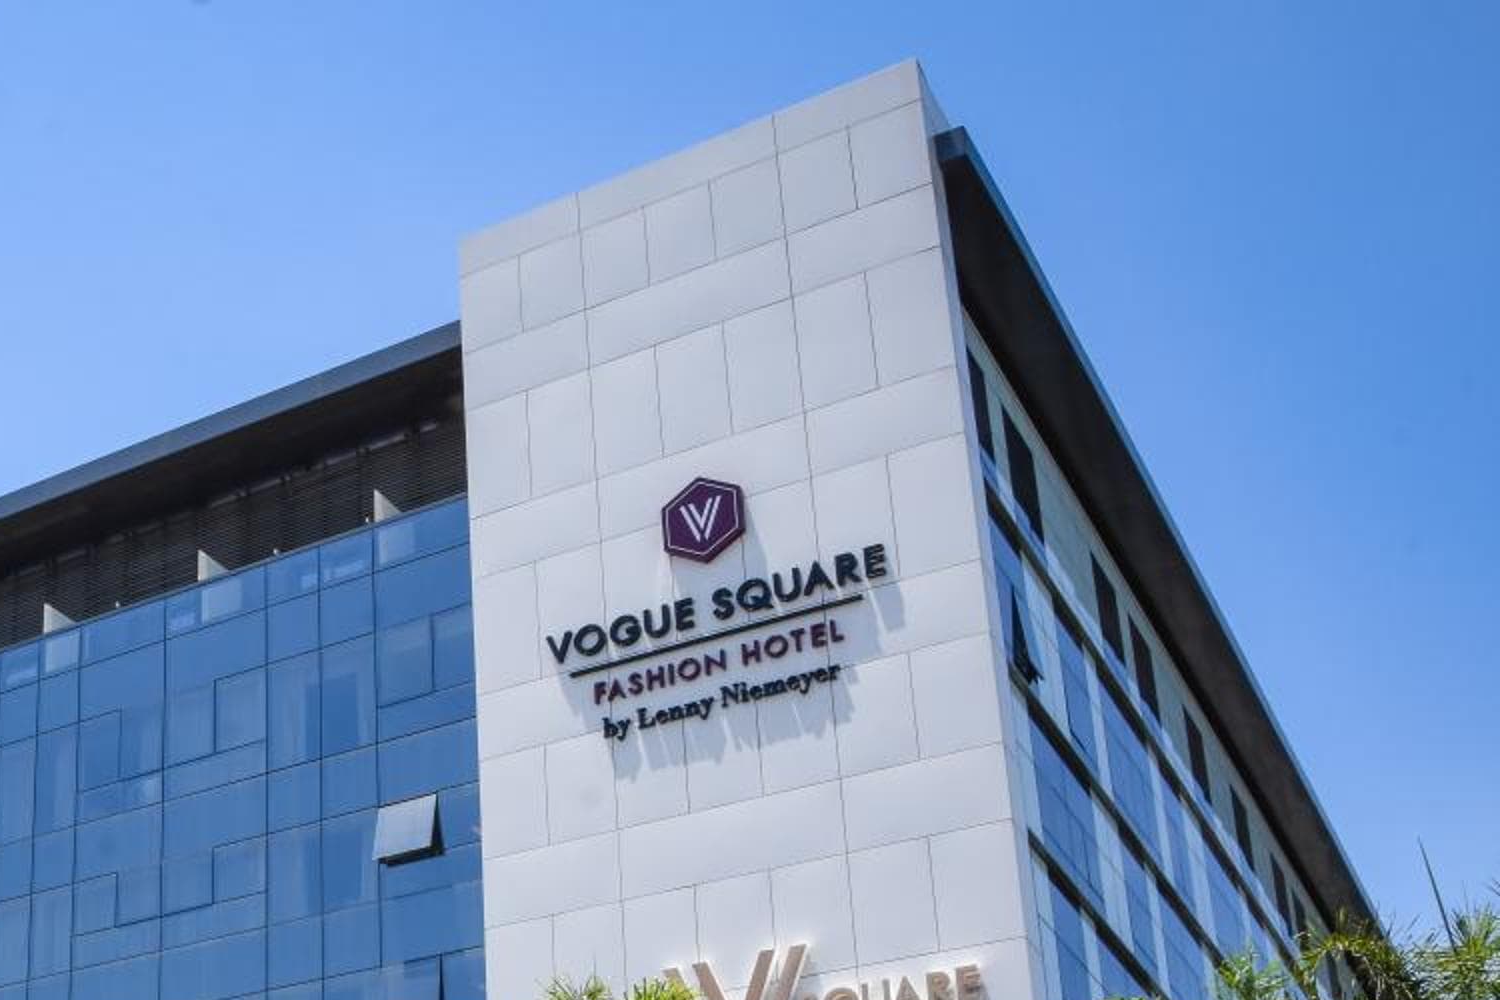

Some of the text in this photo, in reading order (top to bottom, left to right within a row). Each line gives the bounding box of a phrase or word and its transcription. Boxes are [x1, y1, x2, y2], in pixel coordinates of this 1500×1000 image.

[546, 543, 887, 664] VOGUE SQUARE
[593, 619, 845, 705] FASHION HOTEL
[602, 665, 842, 741] by Lenny Niemeyer
